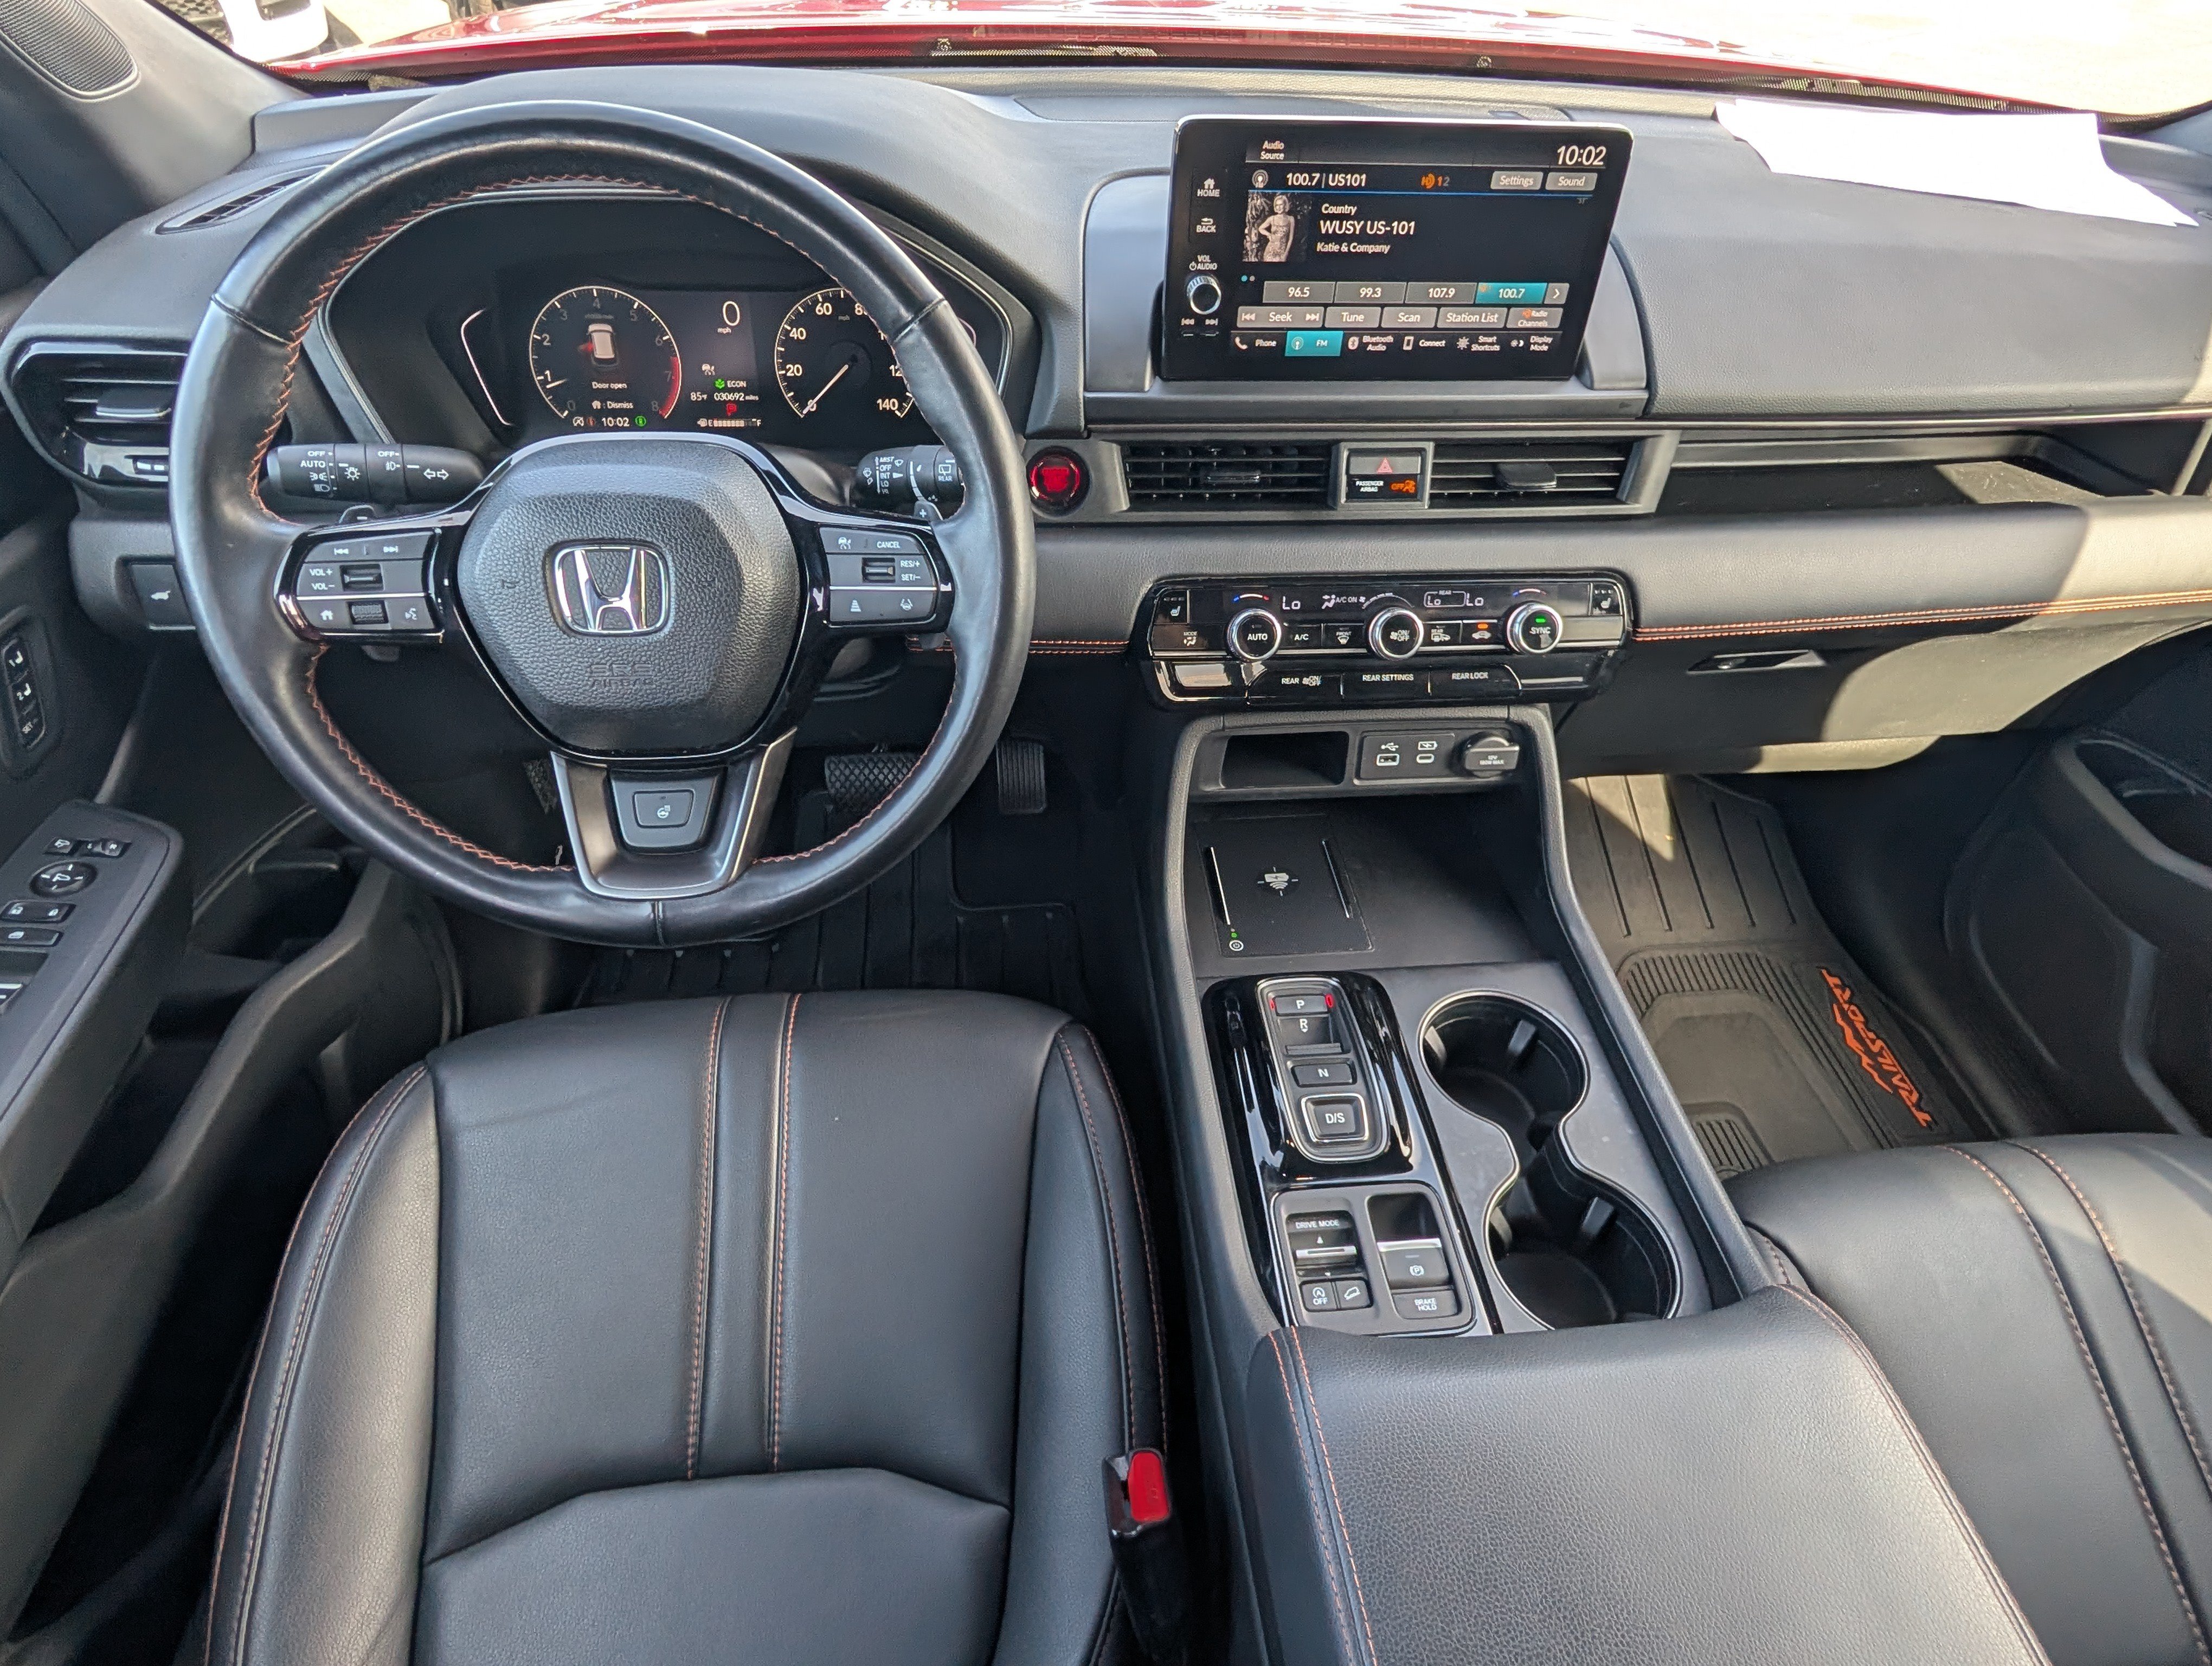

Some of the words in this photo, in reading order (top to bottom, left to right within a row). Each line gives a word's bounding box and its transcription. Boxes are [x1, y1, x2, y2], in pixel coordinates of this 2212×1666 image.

[1263, 141, 1284, 150] Audio
[1261, 151, 1284, 160] Source
[1557, 145, 1606, 165] 10:02
[1286, 172, 1320, 186] 100.7
[1329, 174, 1366, 187] US101
[1499, 175, 1534, 187] Settings
[1558, 176, 1586, 187] Sound
[1322, 203, 1357, 216] Country
[1320, 220, 1364, 235] WUSY
[1366, 221, 1416, 235] US-101
[1316, 242, 1340, 253] Katie
[1341, 242, 1348, 252] &
[1350, 242, 1391, 254] Company
[1288, 286, 1310, 298] 96.5
[1360, 287, 1382, 299] 99.3
[1427, 287, 1456, 298] 107.9
[1498, 288, 1526, 299] 100.7
[723, 300, 741, 326] 0
[815, 303, 832, 315] 60
[854, 304, 867, 316] 8
[1269, 312, 1293, 322] Seek
[1341, 312, 1365, 322] Tune
[1397, 312, 1420, 323] Scan
[1445, 312, 1479, 323] Station
[1481, 312, 1499, 323] List
[789, 327, 806, 340] 40
[1362, 335, 1394, 343] Bluetooth
[542, 334, 551, 345] 2
[1255, 339, 1277, 347] Phone
[1529, 336, 1553, 344] Display
[544, 370, 551, 381] 1
[786, 364, 802, 377] 20
[713, 392, 745, 401] 030692
[607, 401, 634, 409] Dismiss
[877, 398, 898, 411] 140
[601, 417, 630, 427] 10:02
[1282, 596, 1301, 610] Lo
[1427, 595, 1441, 605] Lo
[1466, 593, 1484, 606] Lo
[1296, 1000, 1304, 1009] P
[1300, 1019, 1308, 1028] R
[1821, 969, 1932, 1127] TRAILSPORT
[1318, 1069, 1329, 1077] N
[1325, 1113, 1345, 1124] D/S
